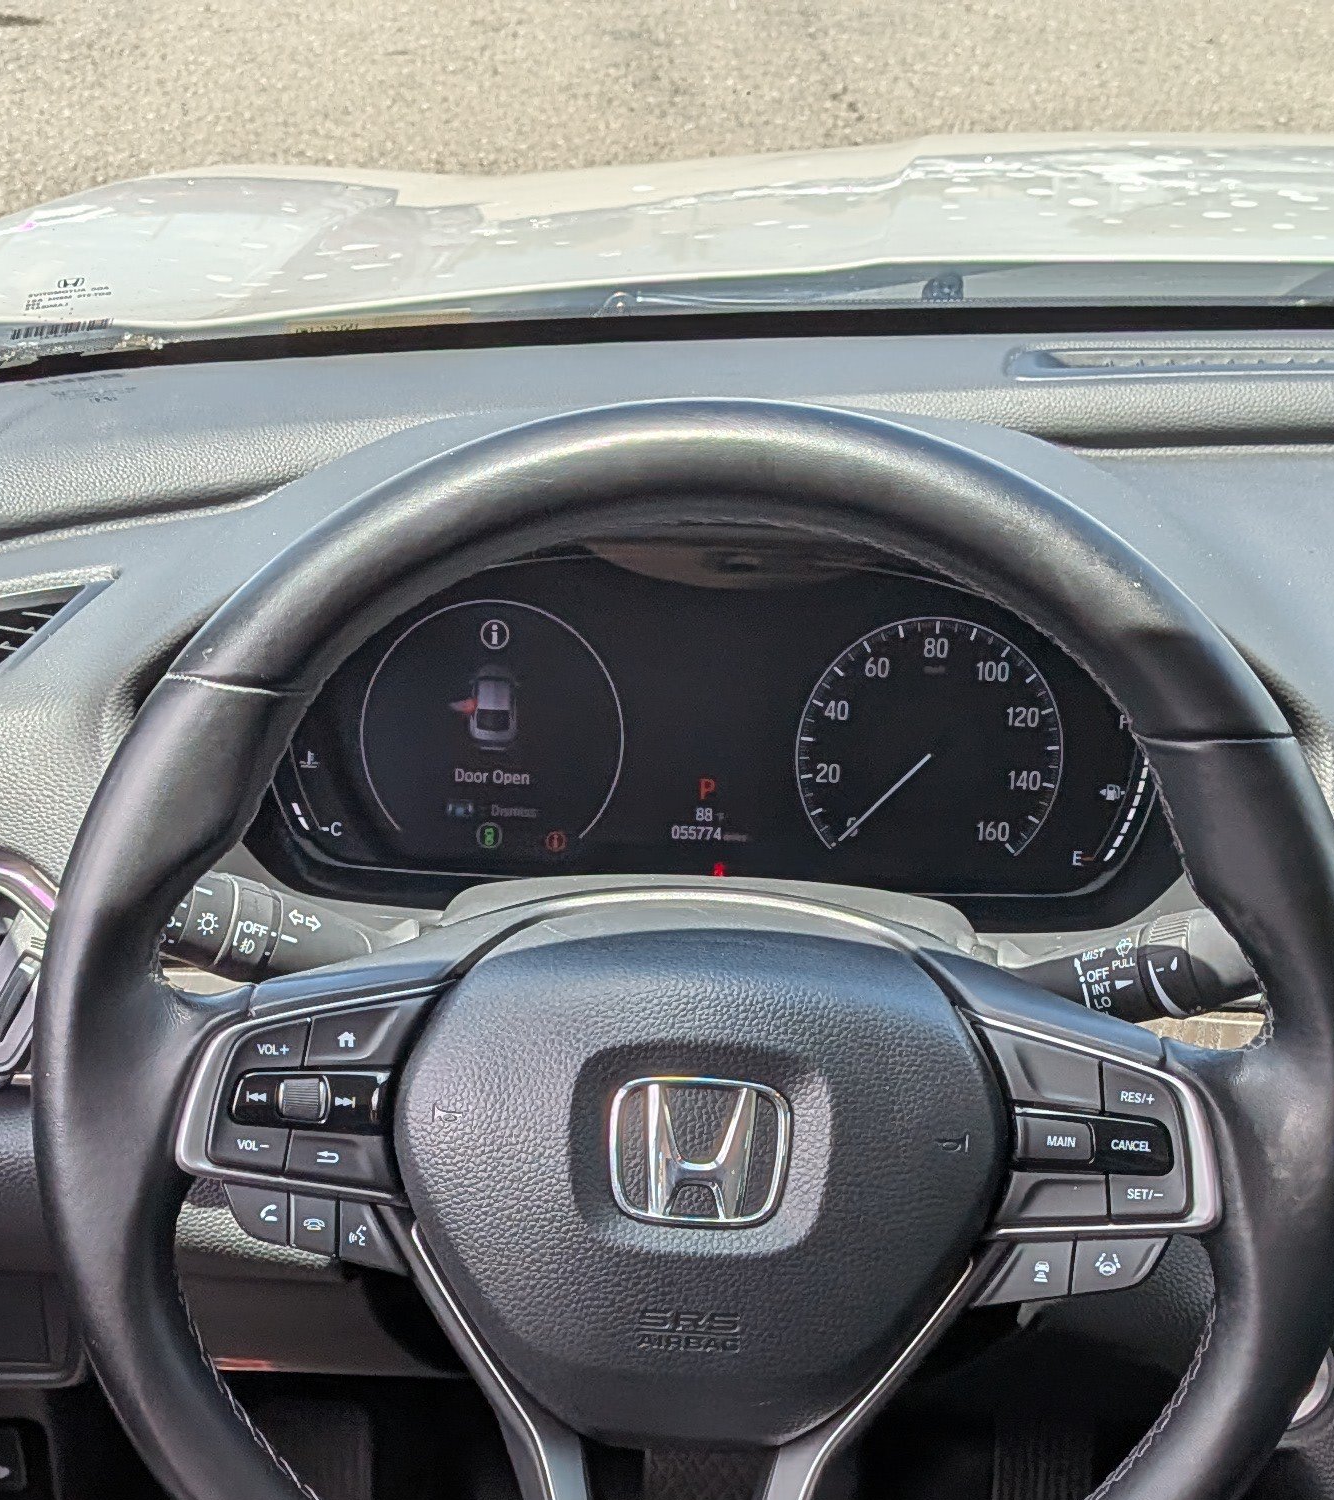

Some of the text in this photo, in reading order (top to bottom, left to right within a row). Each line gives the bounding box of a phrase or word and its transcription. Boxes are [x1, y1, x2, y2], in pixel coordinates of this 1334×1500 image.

[923, 637, 949, 659] 80
[865, 657, 890, 678] 60
[976, 661, 1010, 683] 100
[824, 700, 849, 721] 40
[1006, 706, 1039, 728] 120
[454, 768, 531, 787] Door Open
[815, 763, 841, 784] 20
[1008, 770, 1041, 792] 140
[699, 778, 716, 800] P
[695, 807, 713, 822] 88
[330, 821, 343, 837] C
[671, 824, 722, 841] 055774
[976, 821, 1010, 842] 160
[1071, 851, 1083, 866] E
[241, 920, 269, 937] OFF
[1081, 946, 1107, 962] MIST
[1111, 956, 1136, 970] PULL
[1087, 966, 1110, 983] OFF
[1091, 980, 1111, 996] INT
[1093, 996, 1112, 1010] LO
[1120, 1090, 1156, 1106] RES/+
[1047, 1135, 1077, 1148] MAIN
[1111, 1139, 1152, 1153] CANCEL
[636, 1308, 741, 1334] SRS
[636, 1334, 742, 1355] AIRBAG
